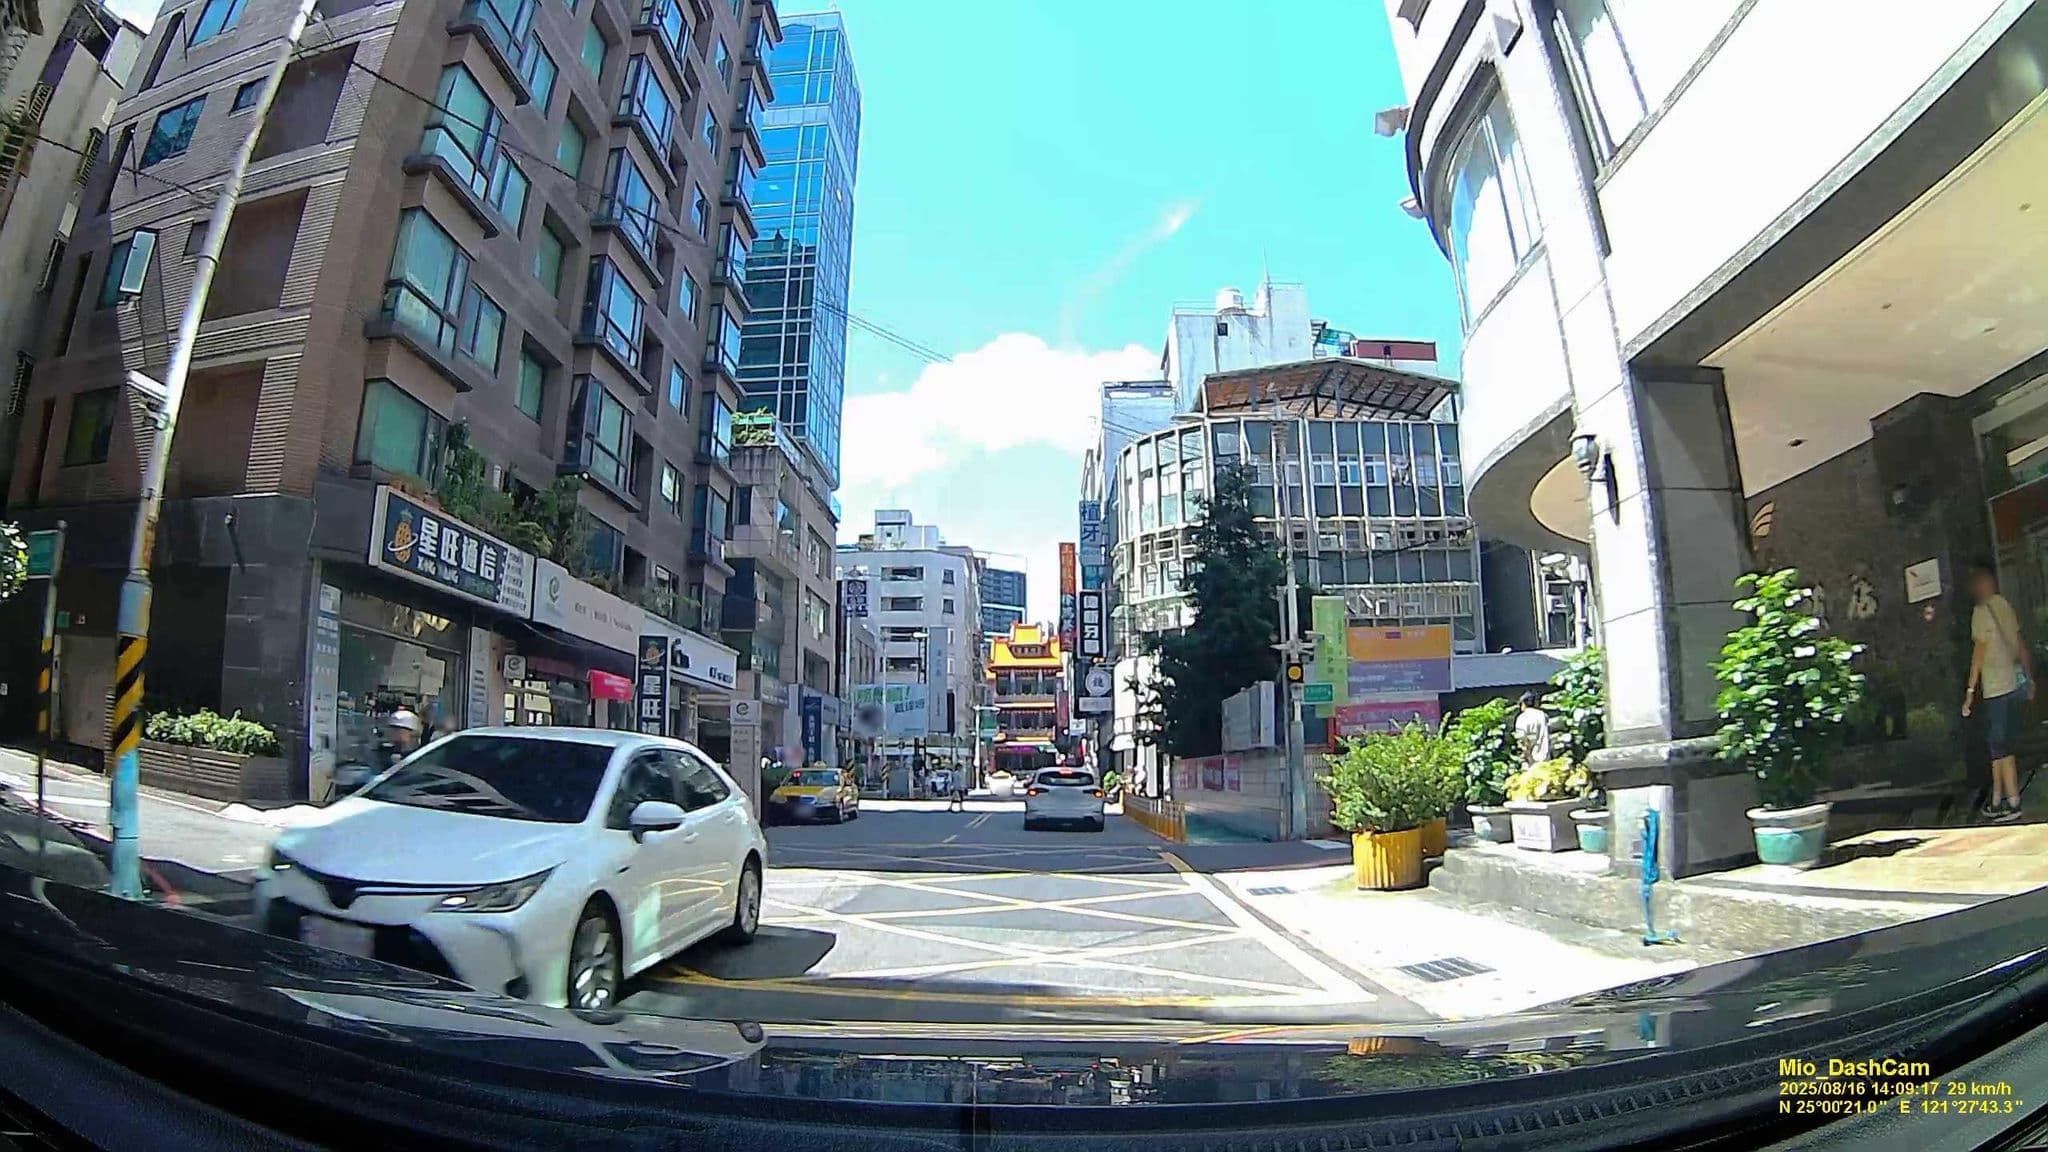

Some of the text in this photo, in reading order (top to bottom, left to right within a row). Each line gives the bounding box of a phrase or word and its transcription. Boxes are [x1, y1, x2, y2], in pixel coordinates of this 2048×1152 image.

[418, 516, 498, 581] 星旺通信
[1081, 503, 1101, 542] 植牙
